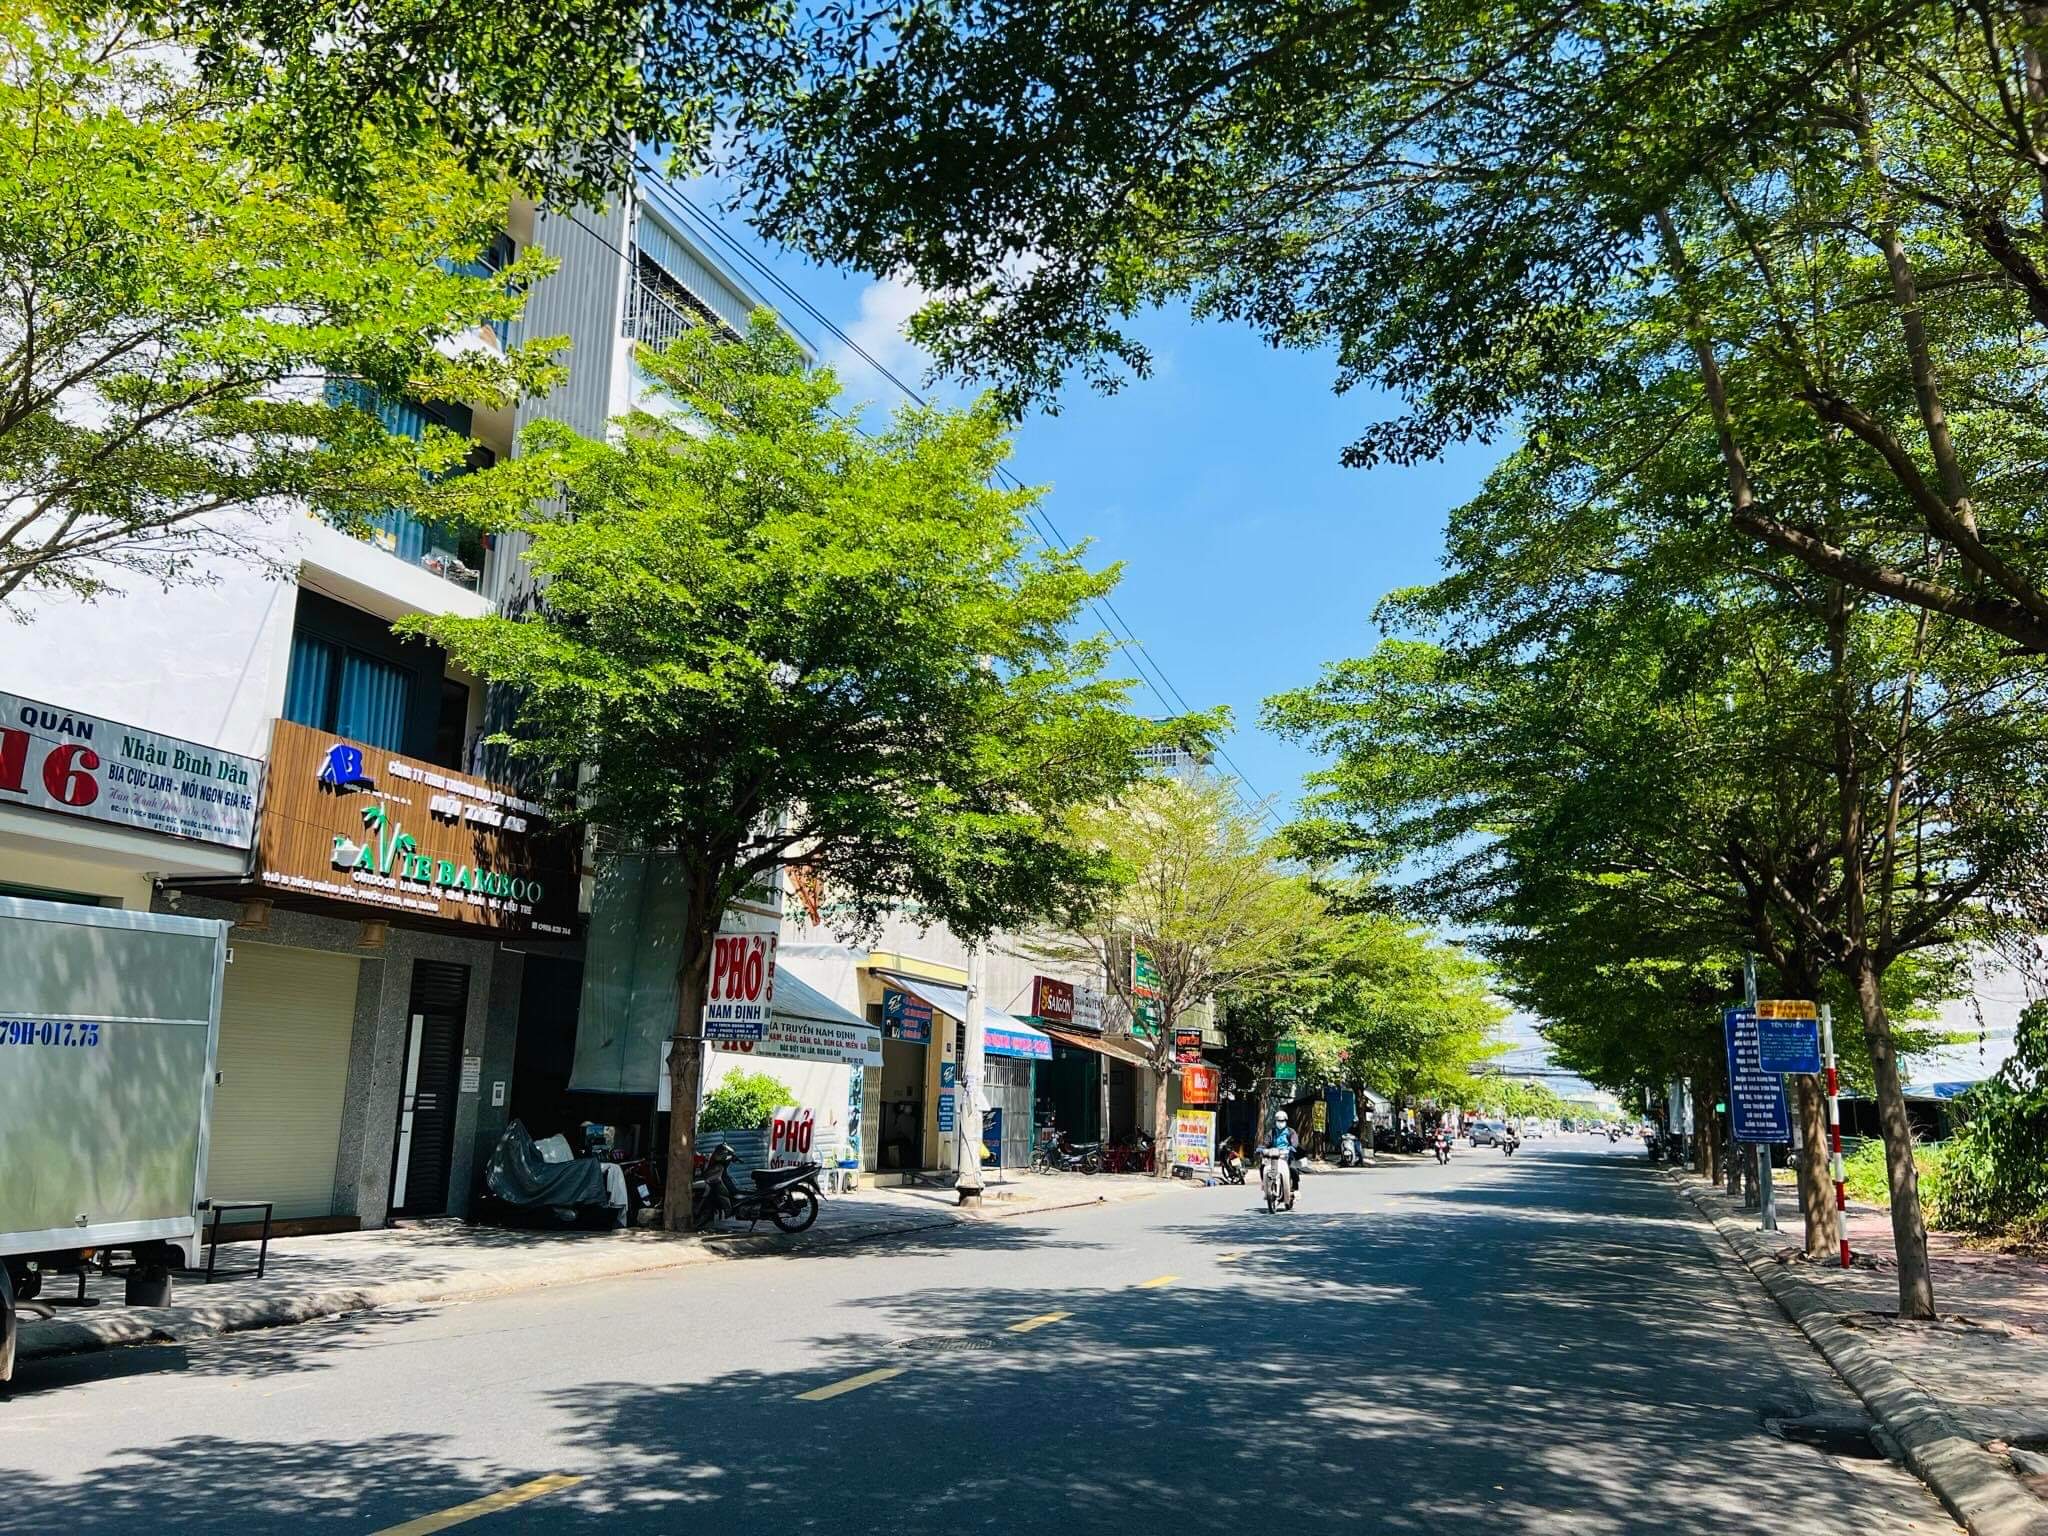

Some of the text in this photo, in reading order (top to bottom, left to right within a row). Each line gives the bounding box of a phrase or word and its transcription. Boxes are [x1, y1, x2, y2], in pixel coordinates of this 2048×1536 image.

[20, 706, 94, 740] QUÁN
[0, 727, 100, 808] 16
[120, 735, 249, 786] Nhậu Bình Dân
[109, 764, 124, 781] BIA
[126, 766, 146, 791] CỰC
[148, 772, 173, 795] LẠNH
[200, 784, 223, 804] NGON
[225, 789, 240, 807] GIÁ
[352, 871, 396, 889] OUTDOOR
[436, 859, 542, 904] BAMBOO
[711, 935, 768, 1003] PHỞ
[708, 1004, 761, 1023] NAM ĐỊNH
[1048, 994, 1072, 1014] SAIGON
[0, 1021, 99, 1047] 79H-017.75
[816, 1028, 834, 1038] NAM
[836, 1030, 856, 1041] ĐỊNH
[771, 1109, 814, 1154] PHỞ
